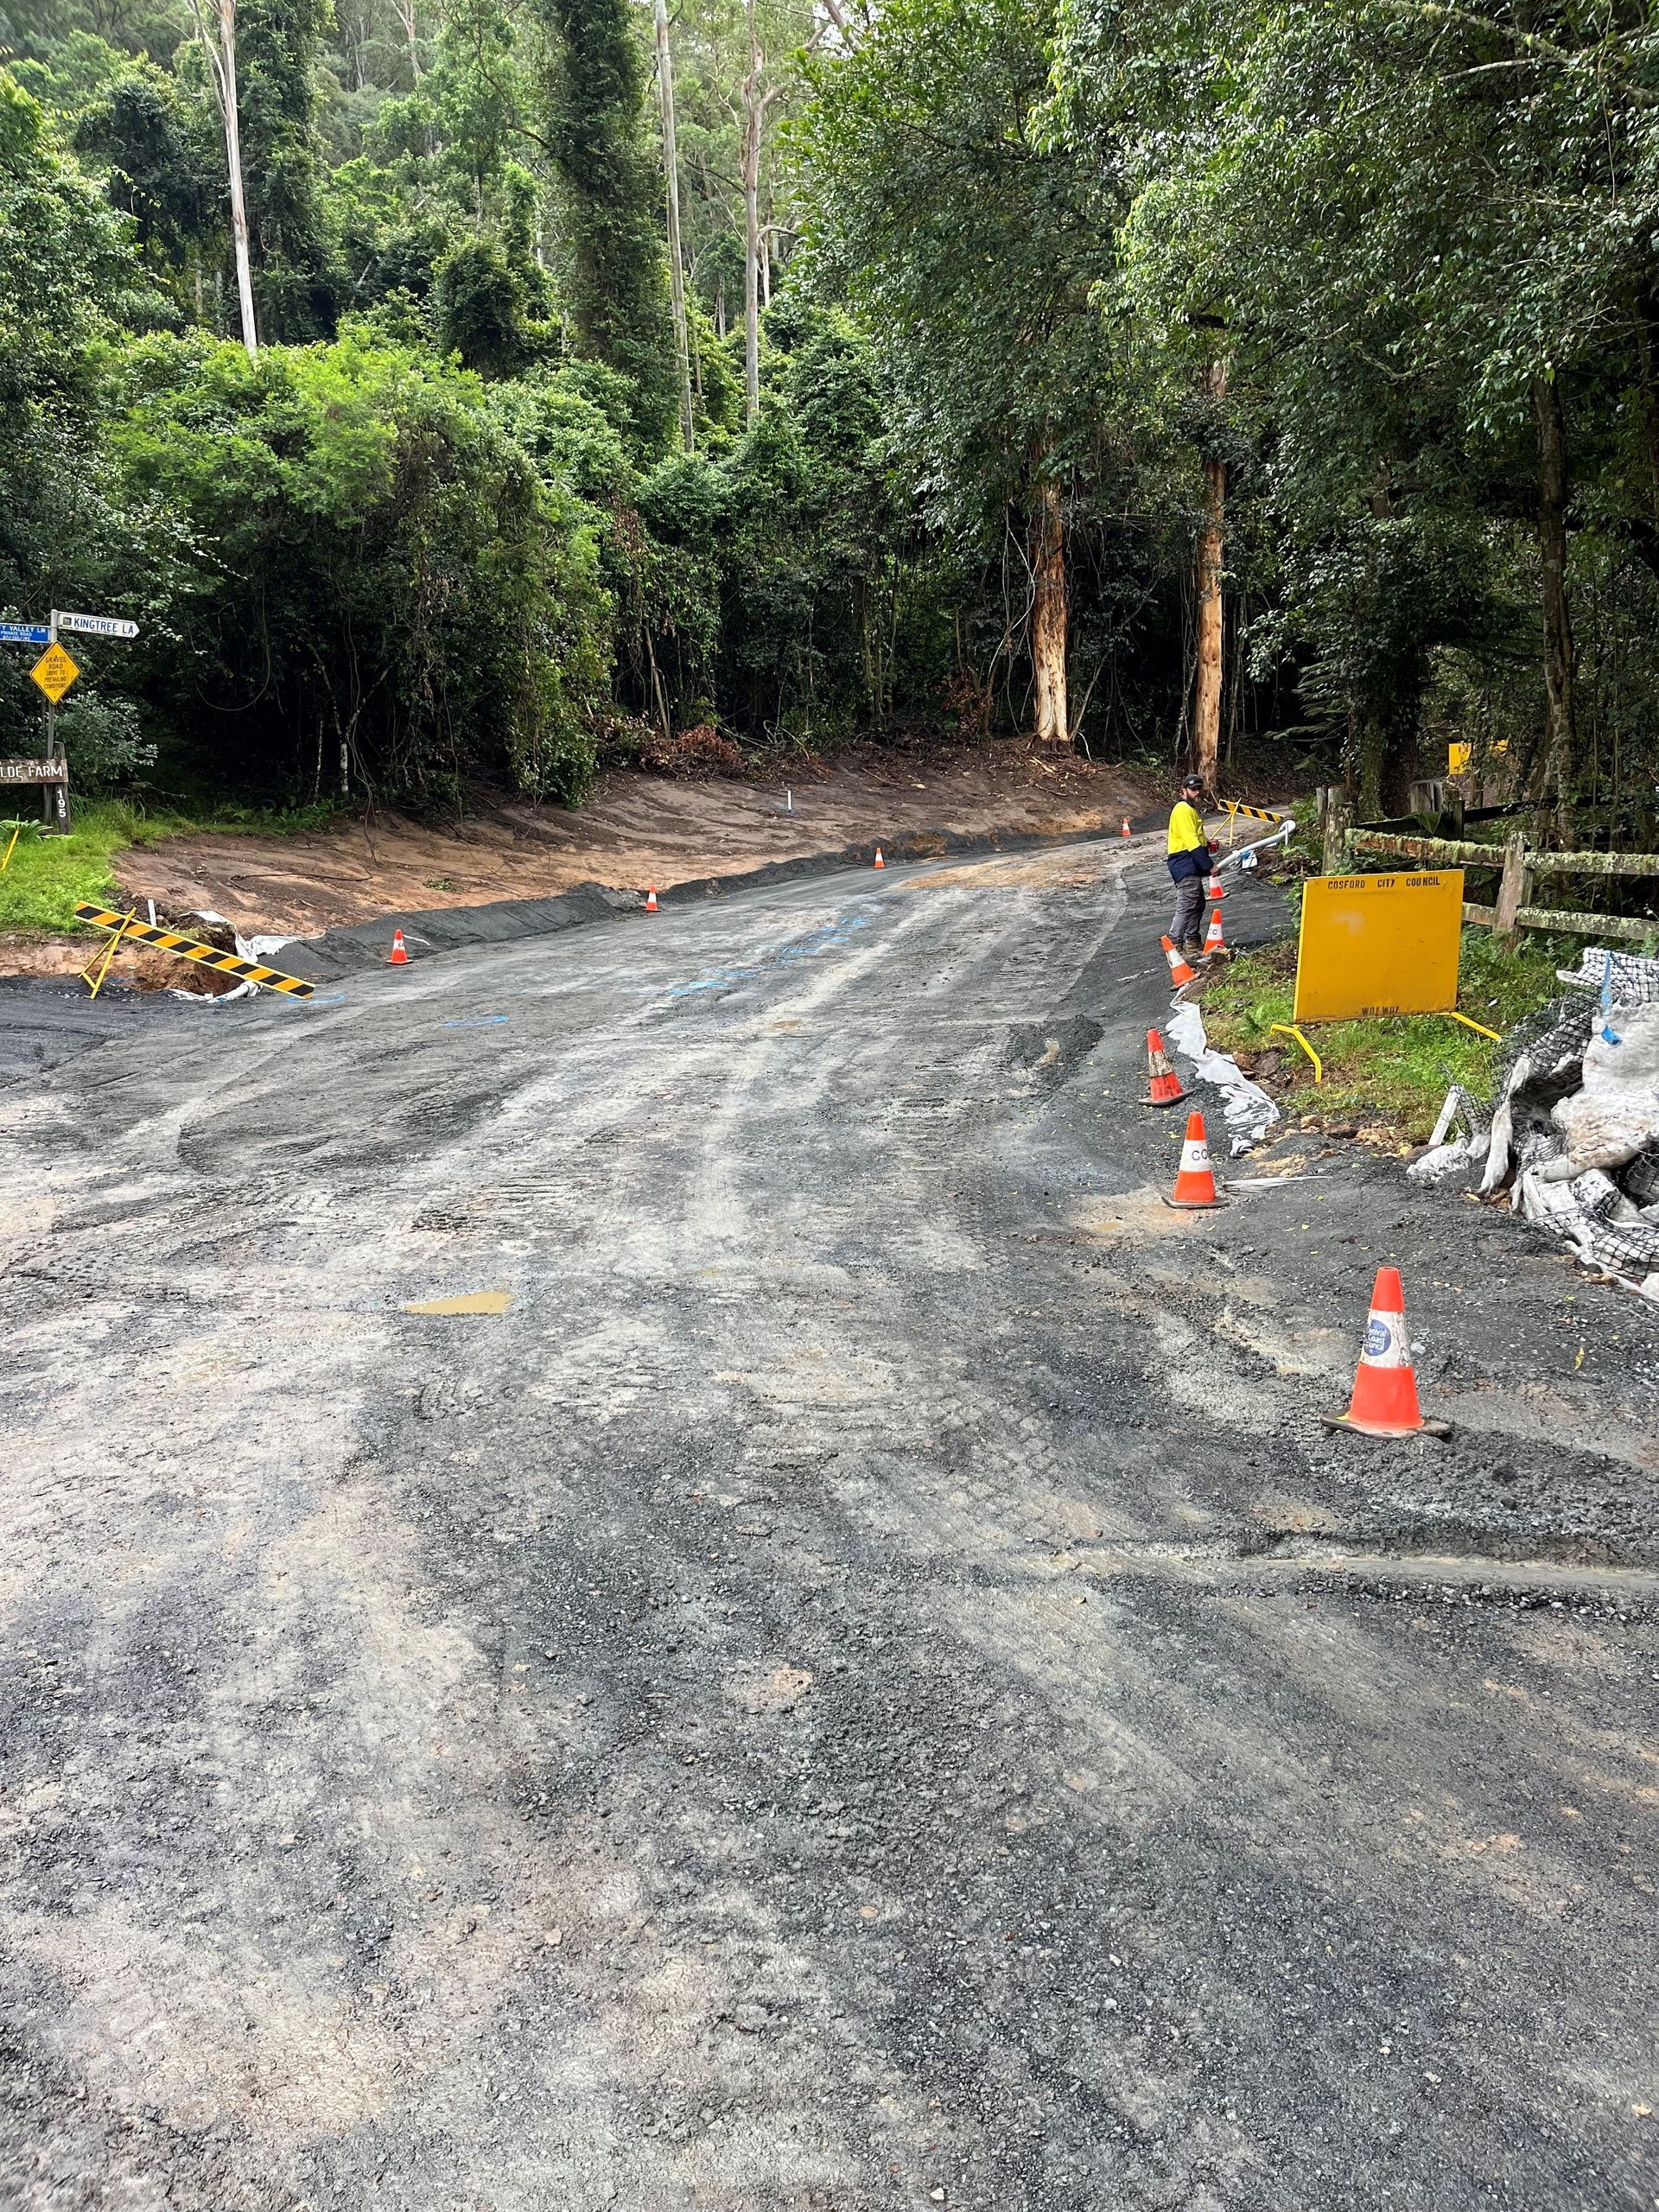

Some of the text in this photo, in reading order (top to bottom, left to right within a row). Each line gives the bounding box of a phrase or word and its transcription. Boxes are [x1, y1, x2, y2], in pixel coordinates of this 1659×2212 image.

[74, 618, 134, 634] KINGTREE LA
[29, 766, 63, 777] FARM
[57, 789, 67, 817] 195
[1377, 878, 1395, 888] CITY
[1406, 876, 1440, 887] COUNCIL
